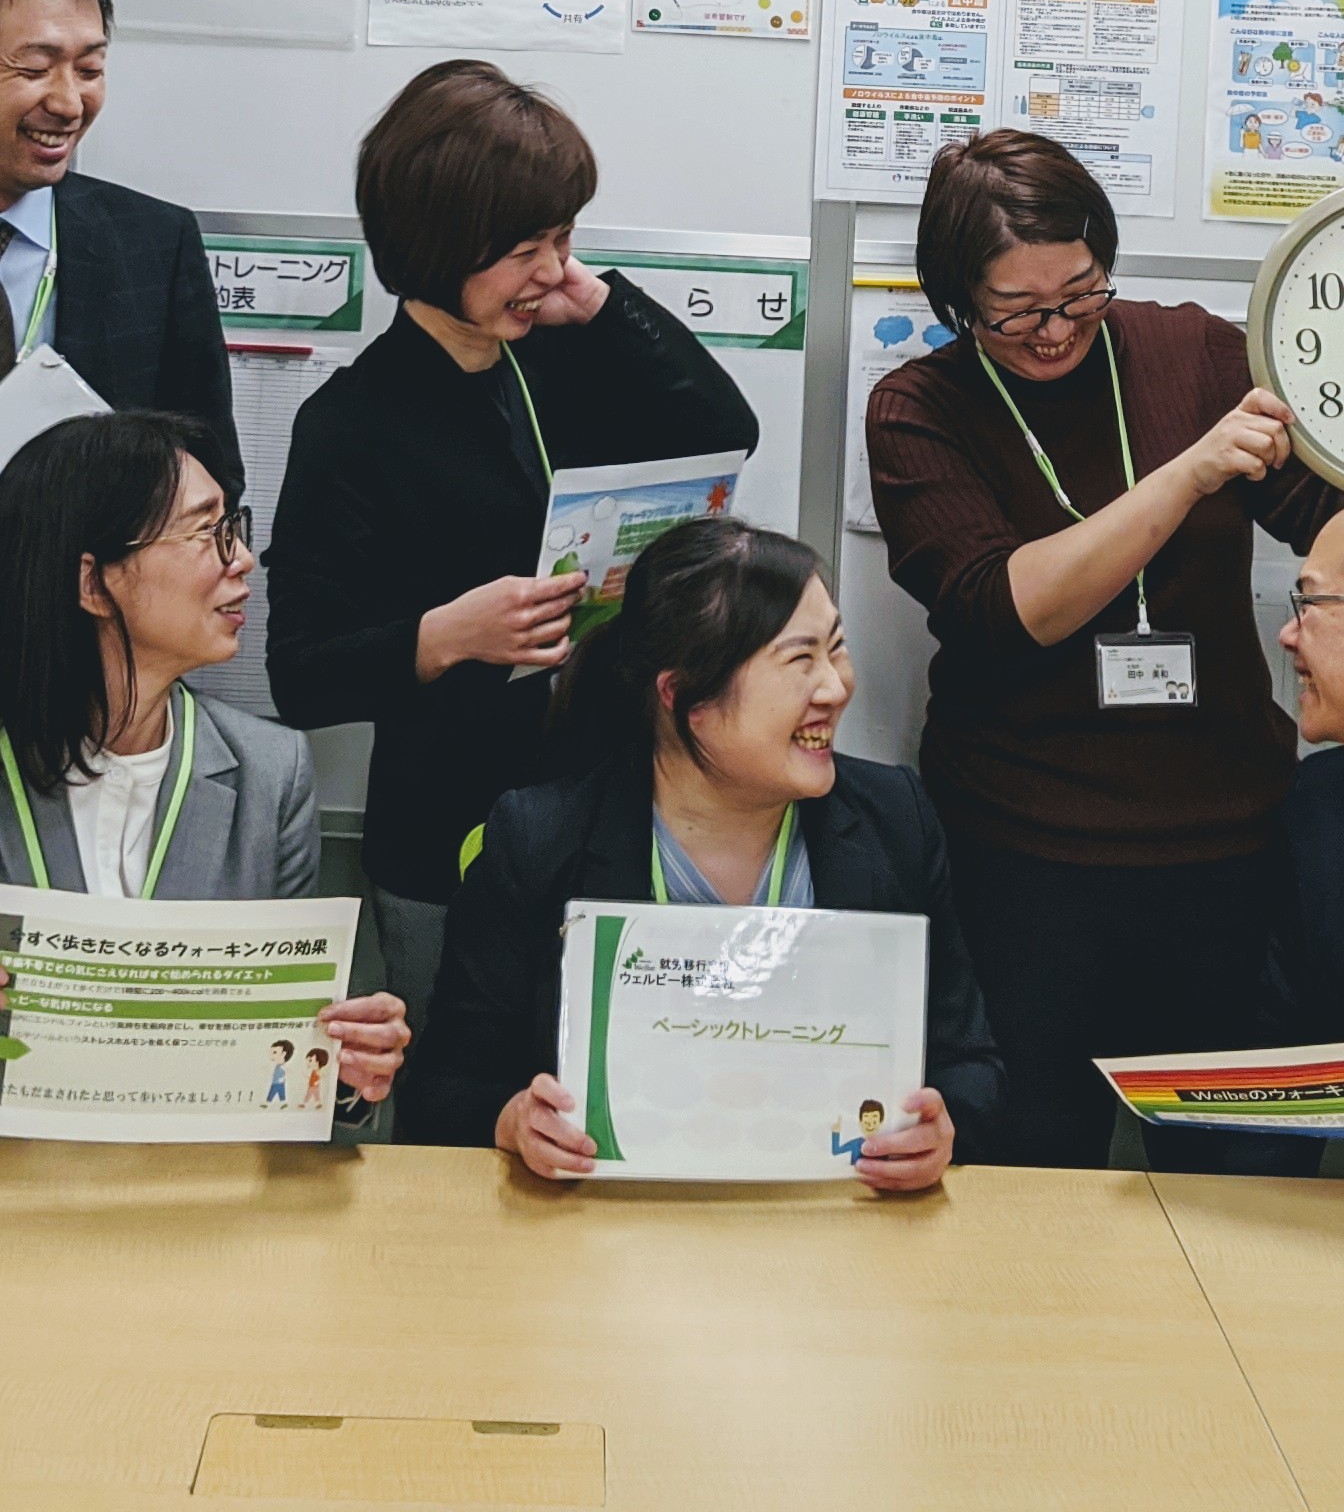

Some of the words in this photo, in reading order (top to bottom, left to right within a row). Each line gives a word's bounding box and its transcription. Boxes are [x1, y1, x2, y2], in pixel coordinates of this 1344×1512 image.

[563, 13, 584, 25] 共有
[215, 255, 348, 284] トレーニング
[1294, 327, 1322, 365] 9
[1318, 380, 1344, 418] 8
[652, 1015, 846, 1044] ベーシックトレーニング
